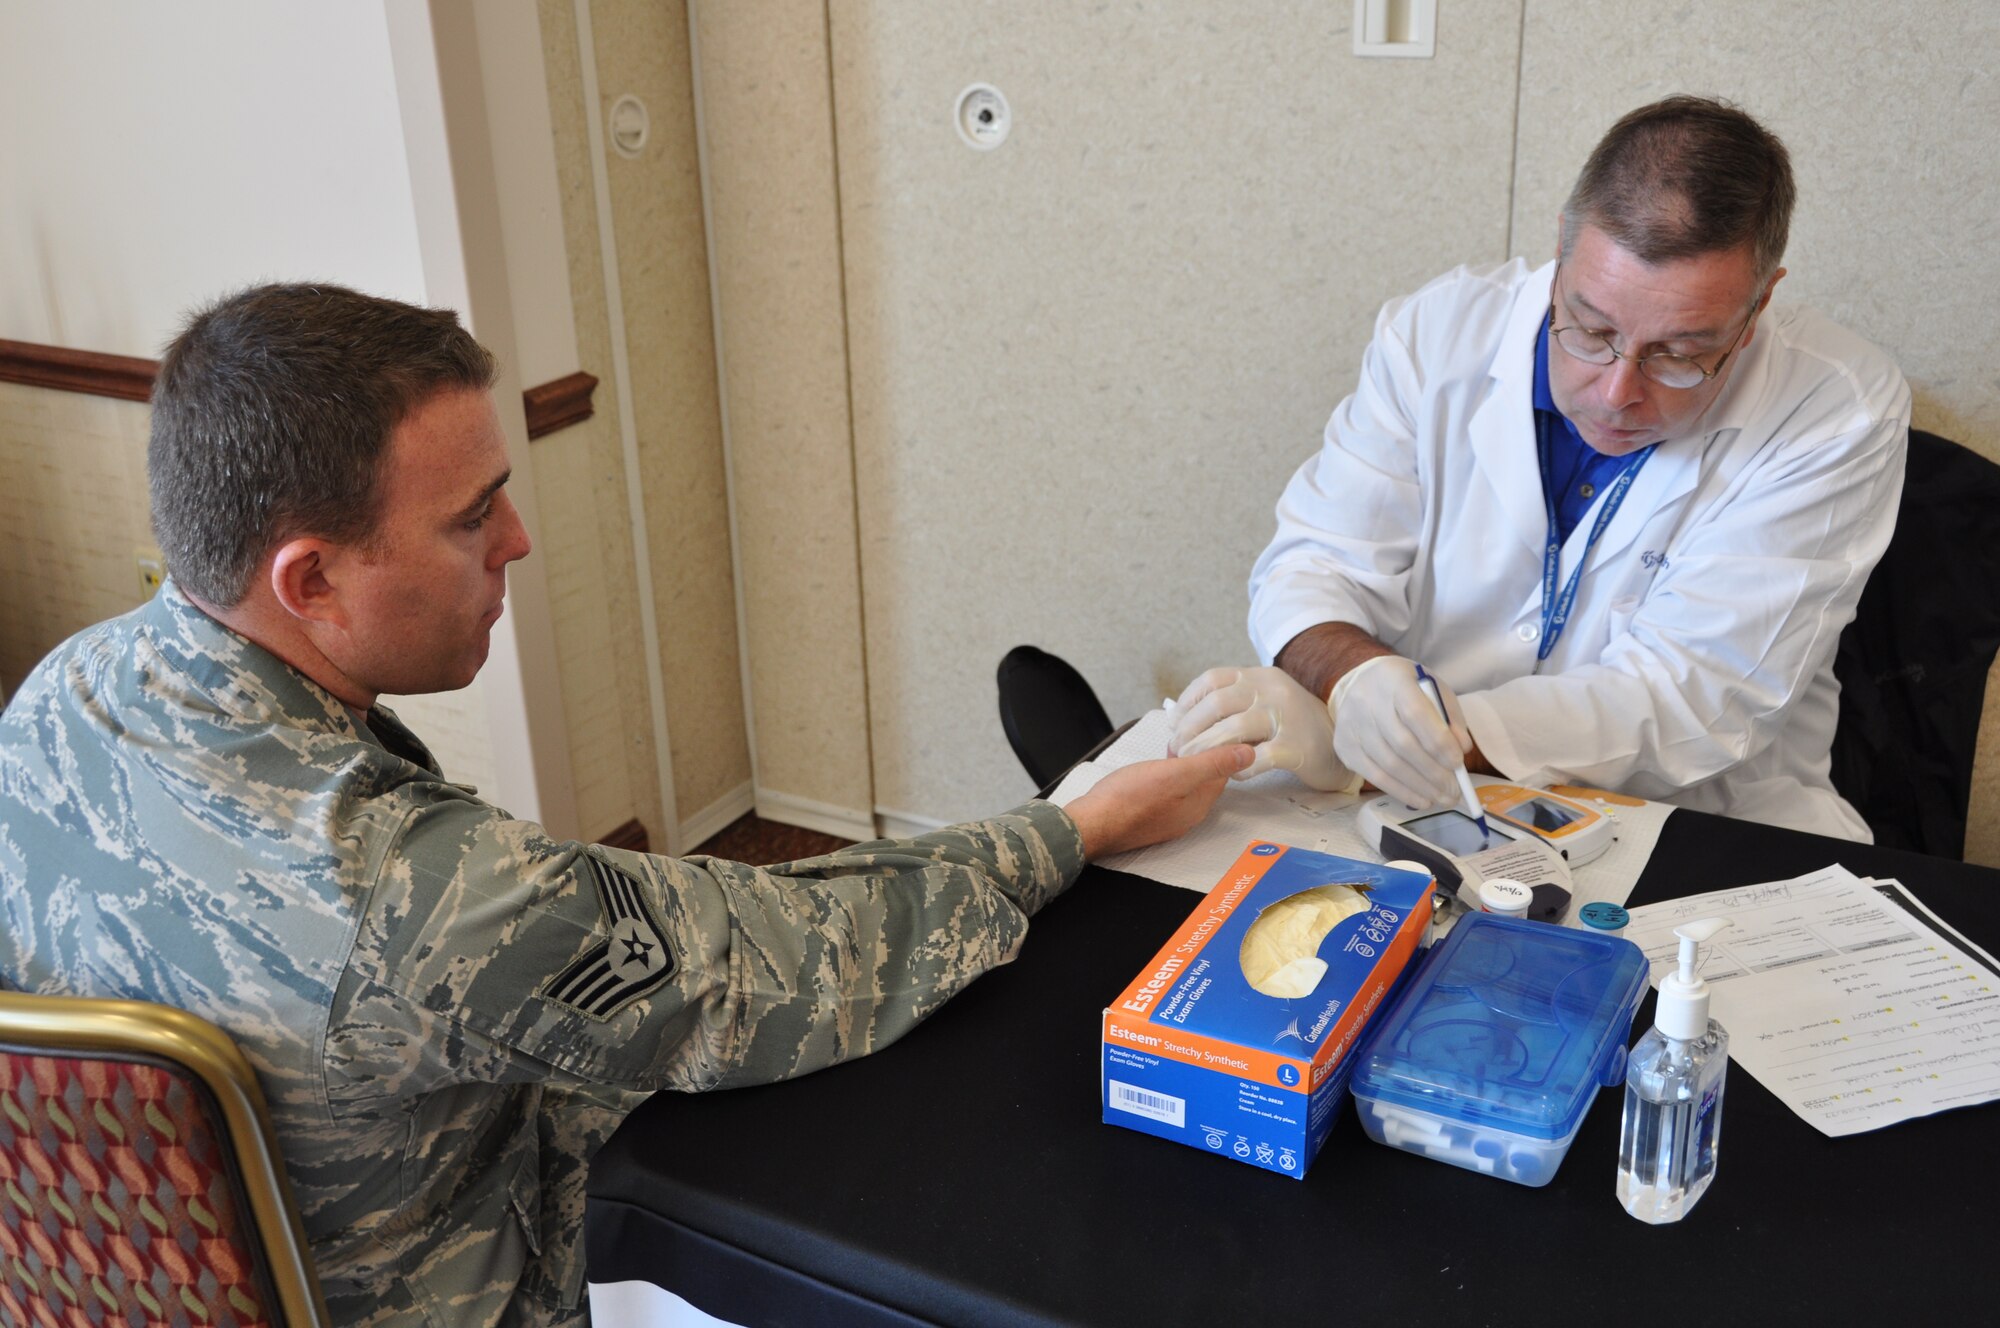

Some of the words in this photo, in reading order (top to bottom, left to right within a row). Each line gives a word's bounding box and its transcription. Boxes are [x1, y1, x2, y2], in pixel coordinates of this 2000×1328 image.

[1176, 916, 1222, 953] Stretchy
[1209, 874, 1255, 914] Synthetic
[1159, 975, 1198, 1020] Powder-Free
[1190, 959, 1211, 978] Vinyl
[1173, 999, 1195, 1023] Exam
[1189, 977, 1212, 1001] Gloves
[1109, 1048, 1144, 1062] Powder-Free
[1144, 1057, 1160, 1066] Vinyl
[1109, 1055, 1126, 1064] Exam
[1125, 1060, 1145, 1069] Gloves
[1164, 1041, 1202, 1060] Stretchy
[1204, 1051, 1249, 1071] Synthetic
[1285, 1068, 1292, 1079] L
